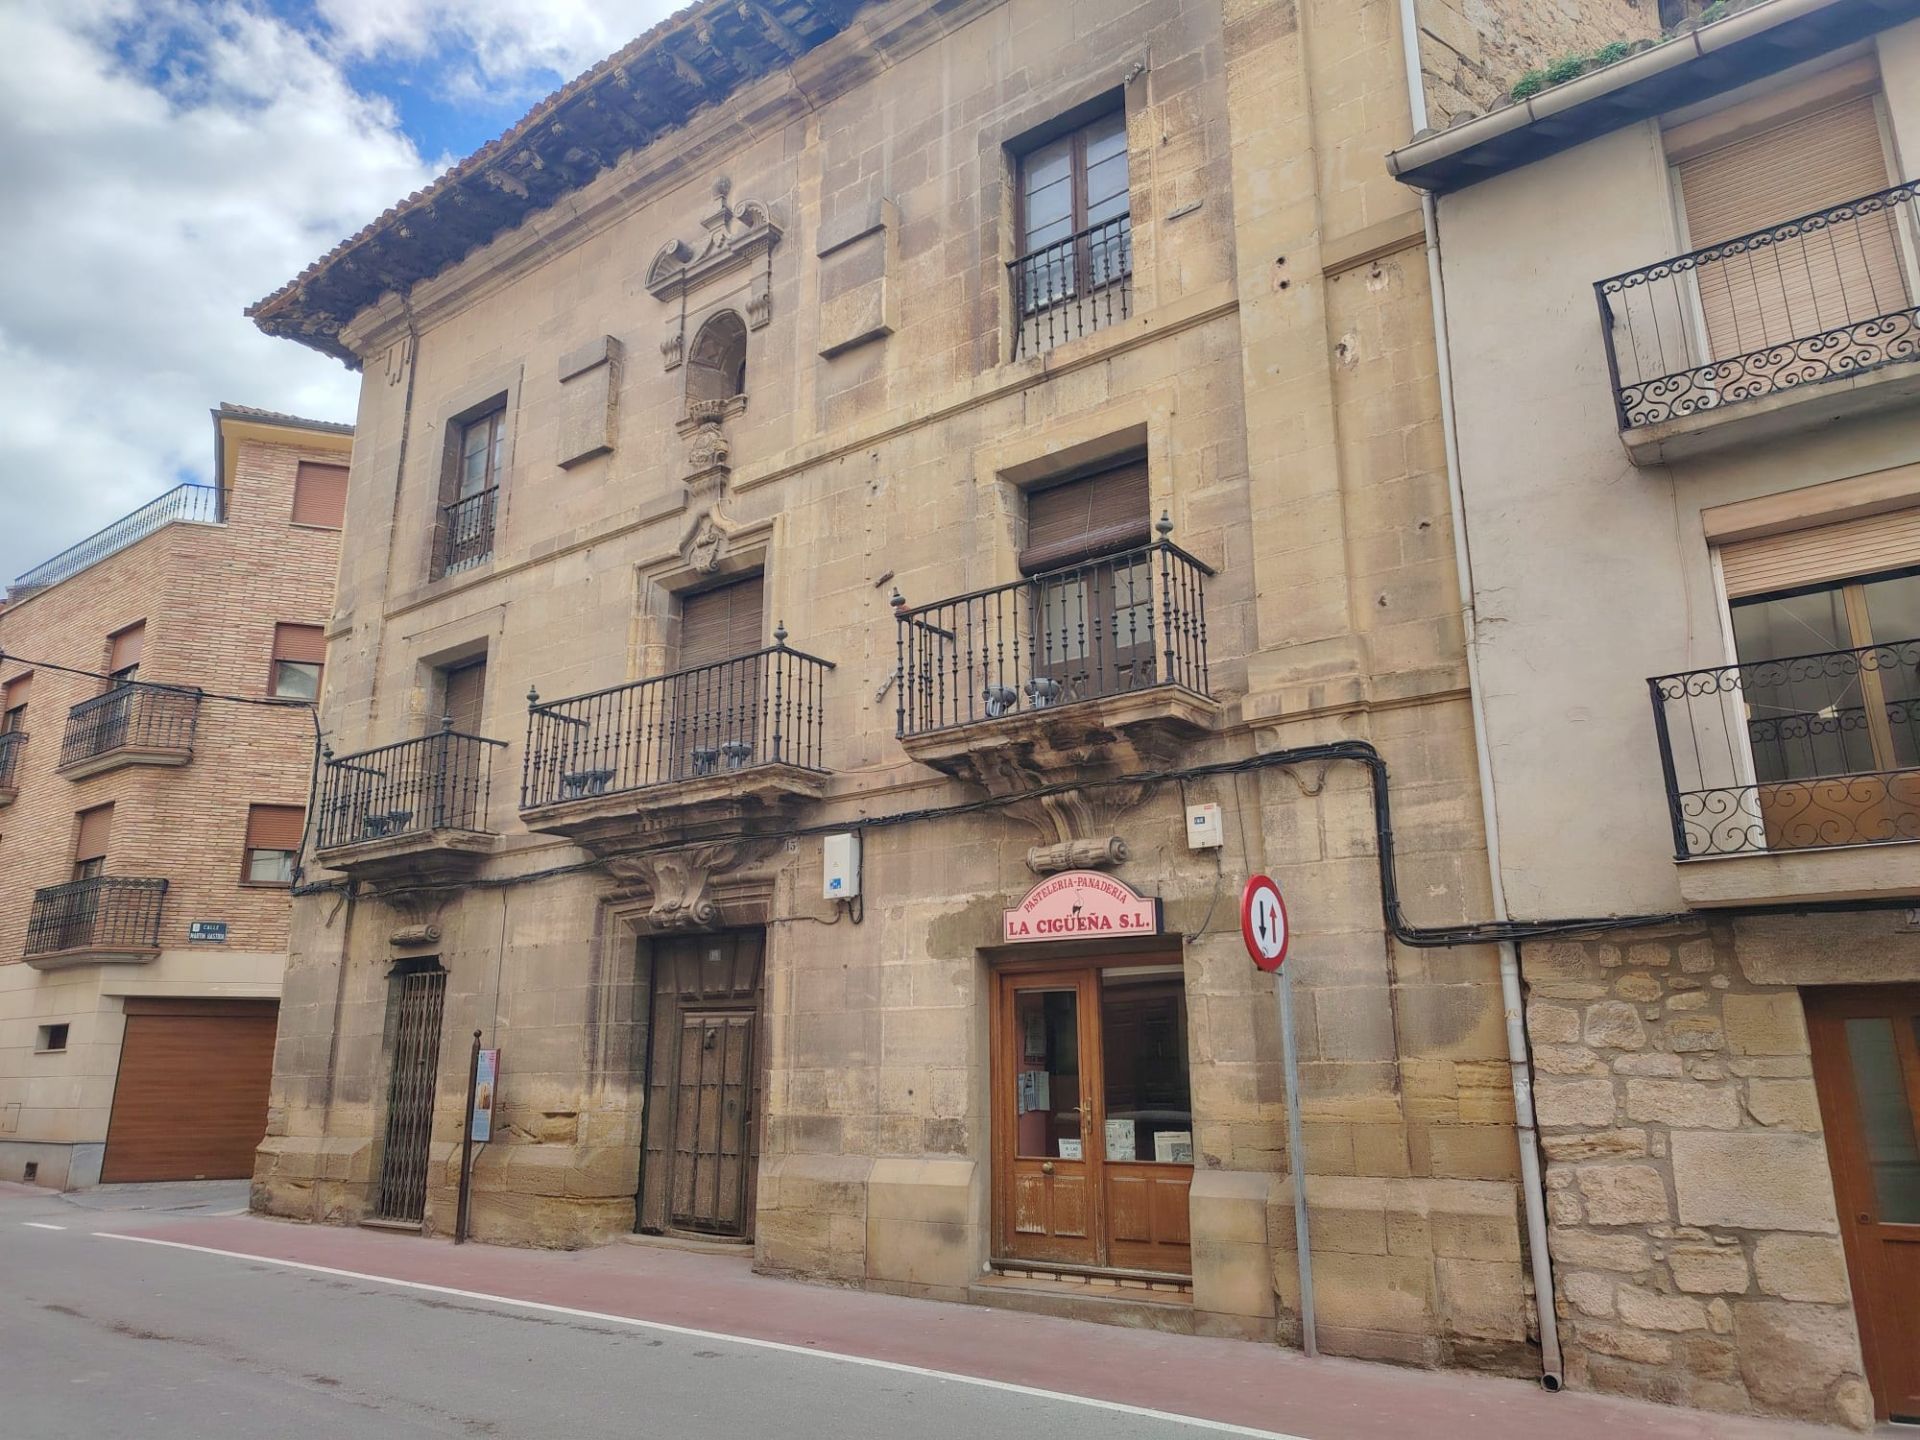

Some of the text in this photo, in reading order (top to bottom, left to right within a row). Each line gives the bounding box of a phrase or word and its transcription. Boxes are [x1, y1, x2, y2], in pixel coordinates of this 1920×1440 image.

[1023, 877, 1127, 913] PASTELERIA-PANADERIA
[1009, 913, 1150, 936] LA CIGÜEÑA S.L.
